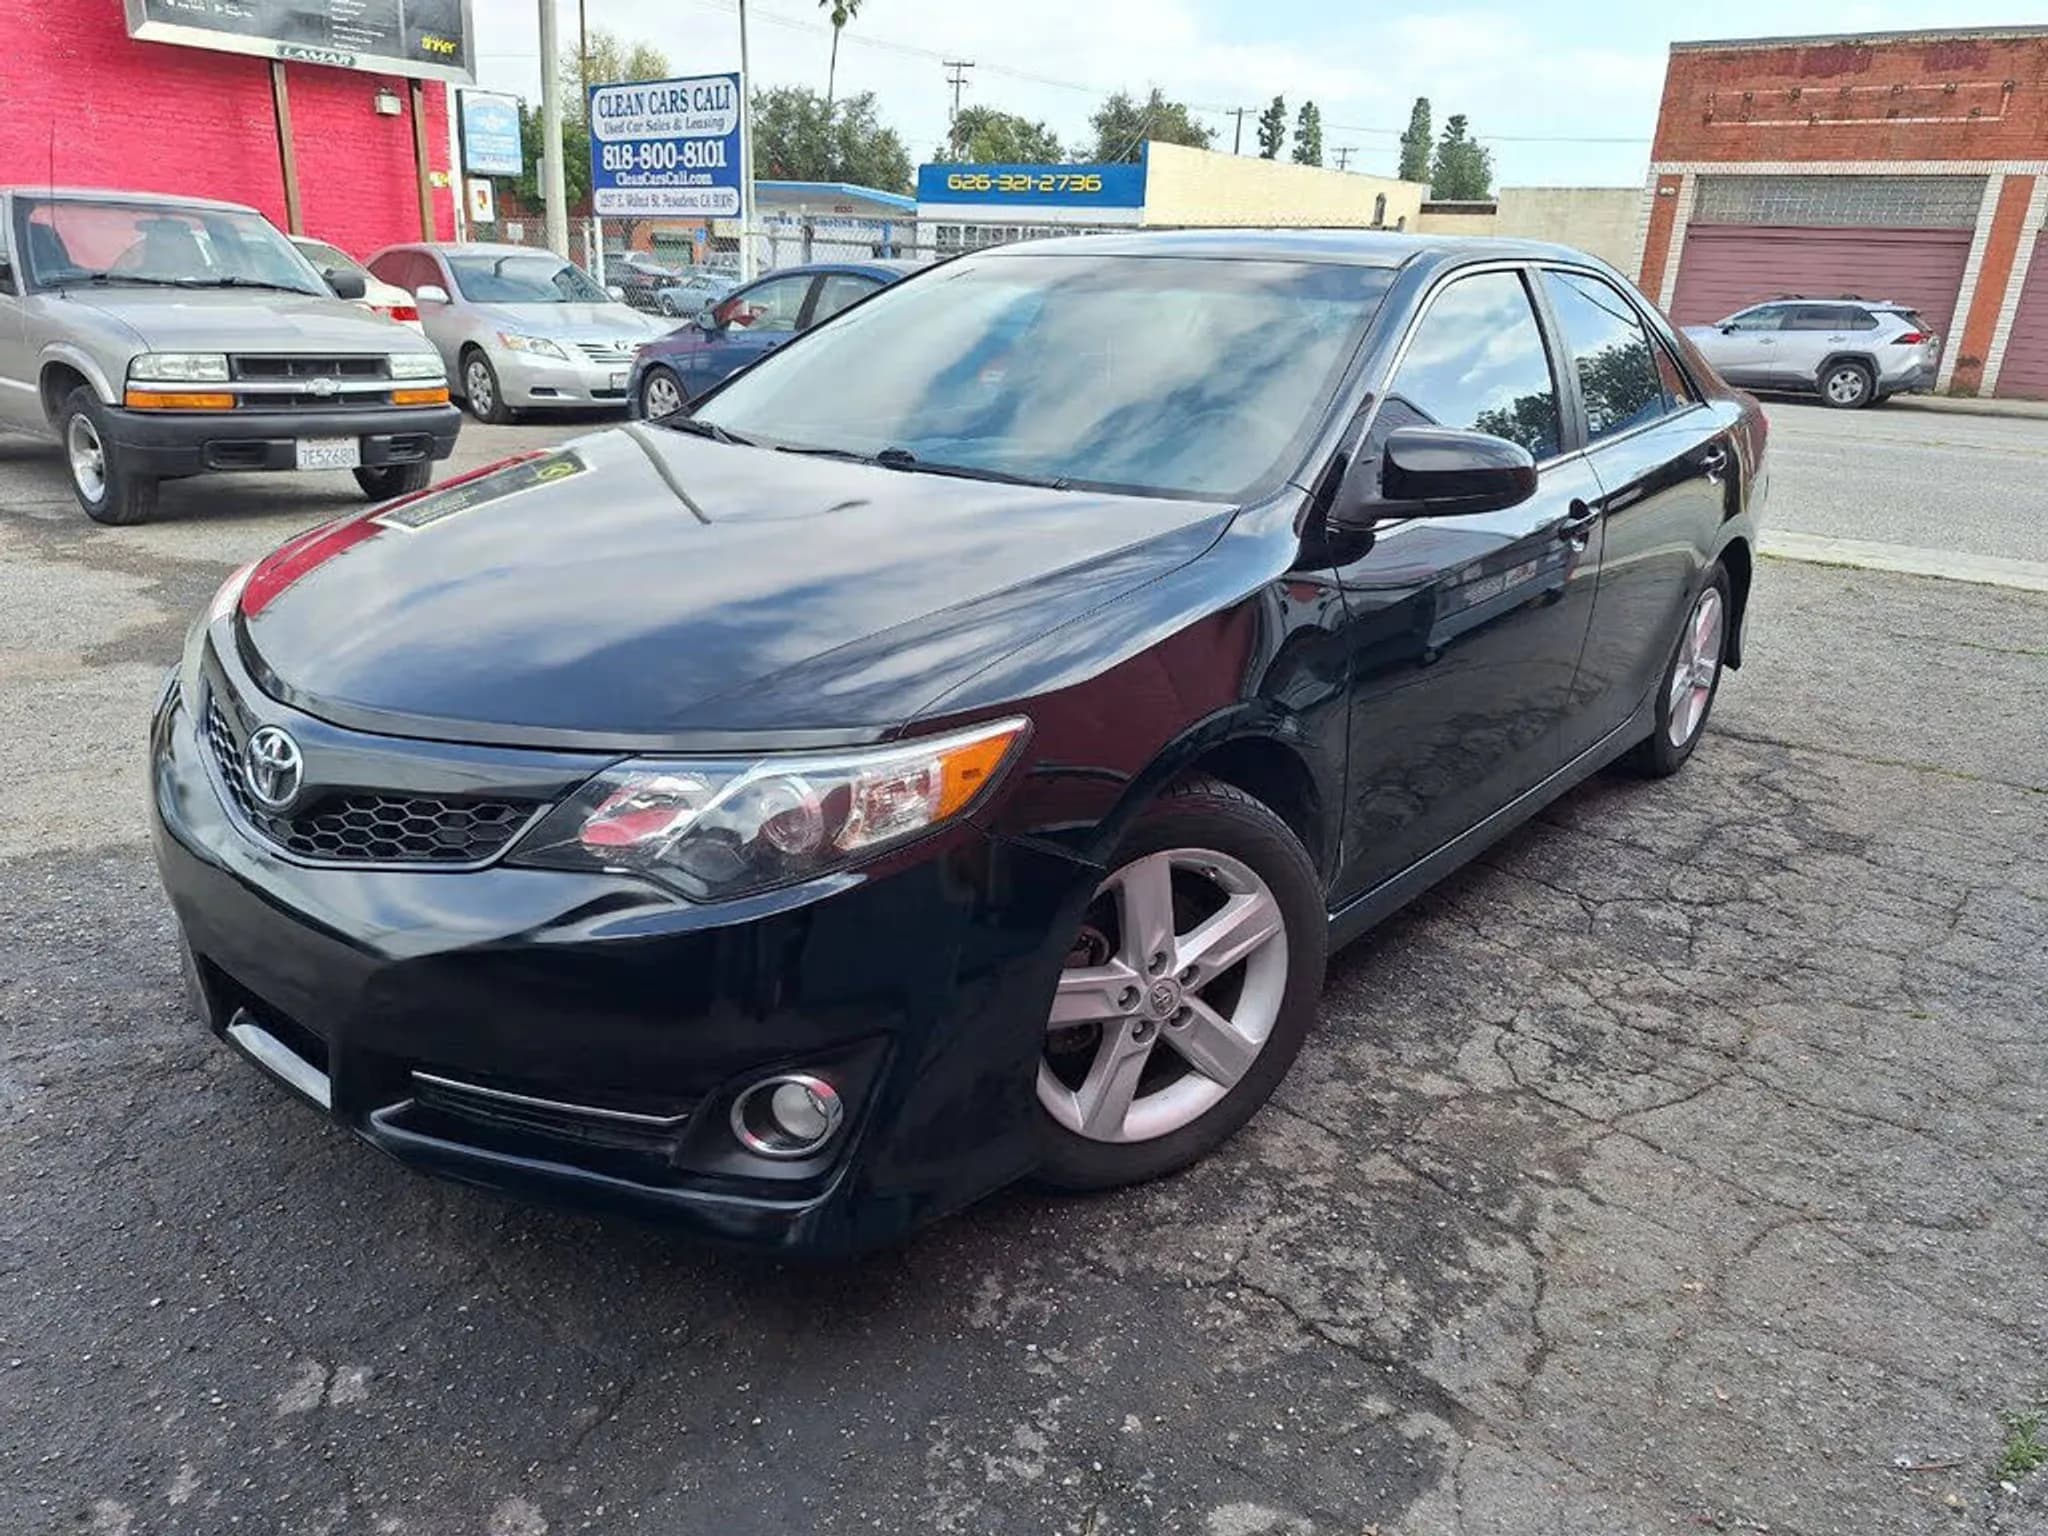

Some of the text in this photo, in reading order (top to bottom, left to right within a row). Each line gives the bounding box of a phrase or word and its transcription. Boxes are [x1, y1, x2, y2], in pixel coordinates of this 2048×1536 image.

[283, 47, 352, 67] LAMAR
[599, 84, 730, 118] CLEAN CARS CALI
[604, 116, 726, 134] Used Car Sales & Leasing
[602, 139, 728, 171] 818-800-8101
[947, 173, 1103, 193] 626-321-2736
